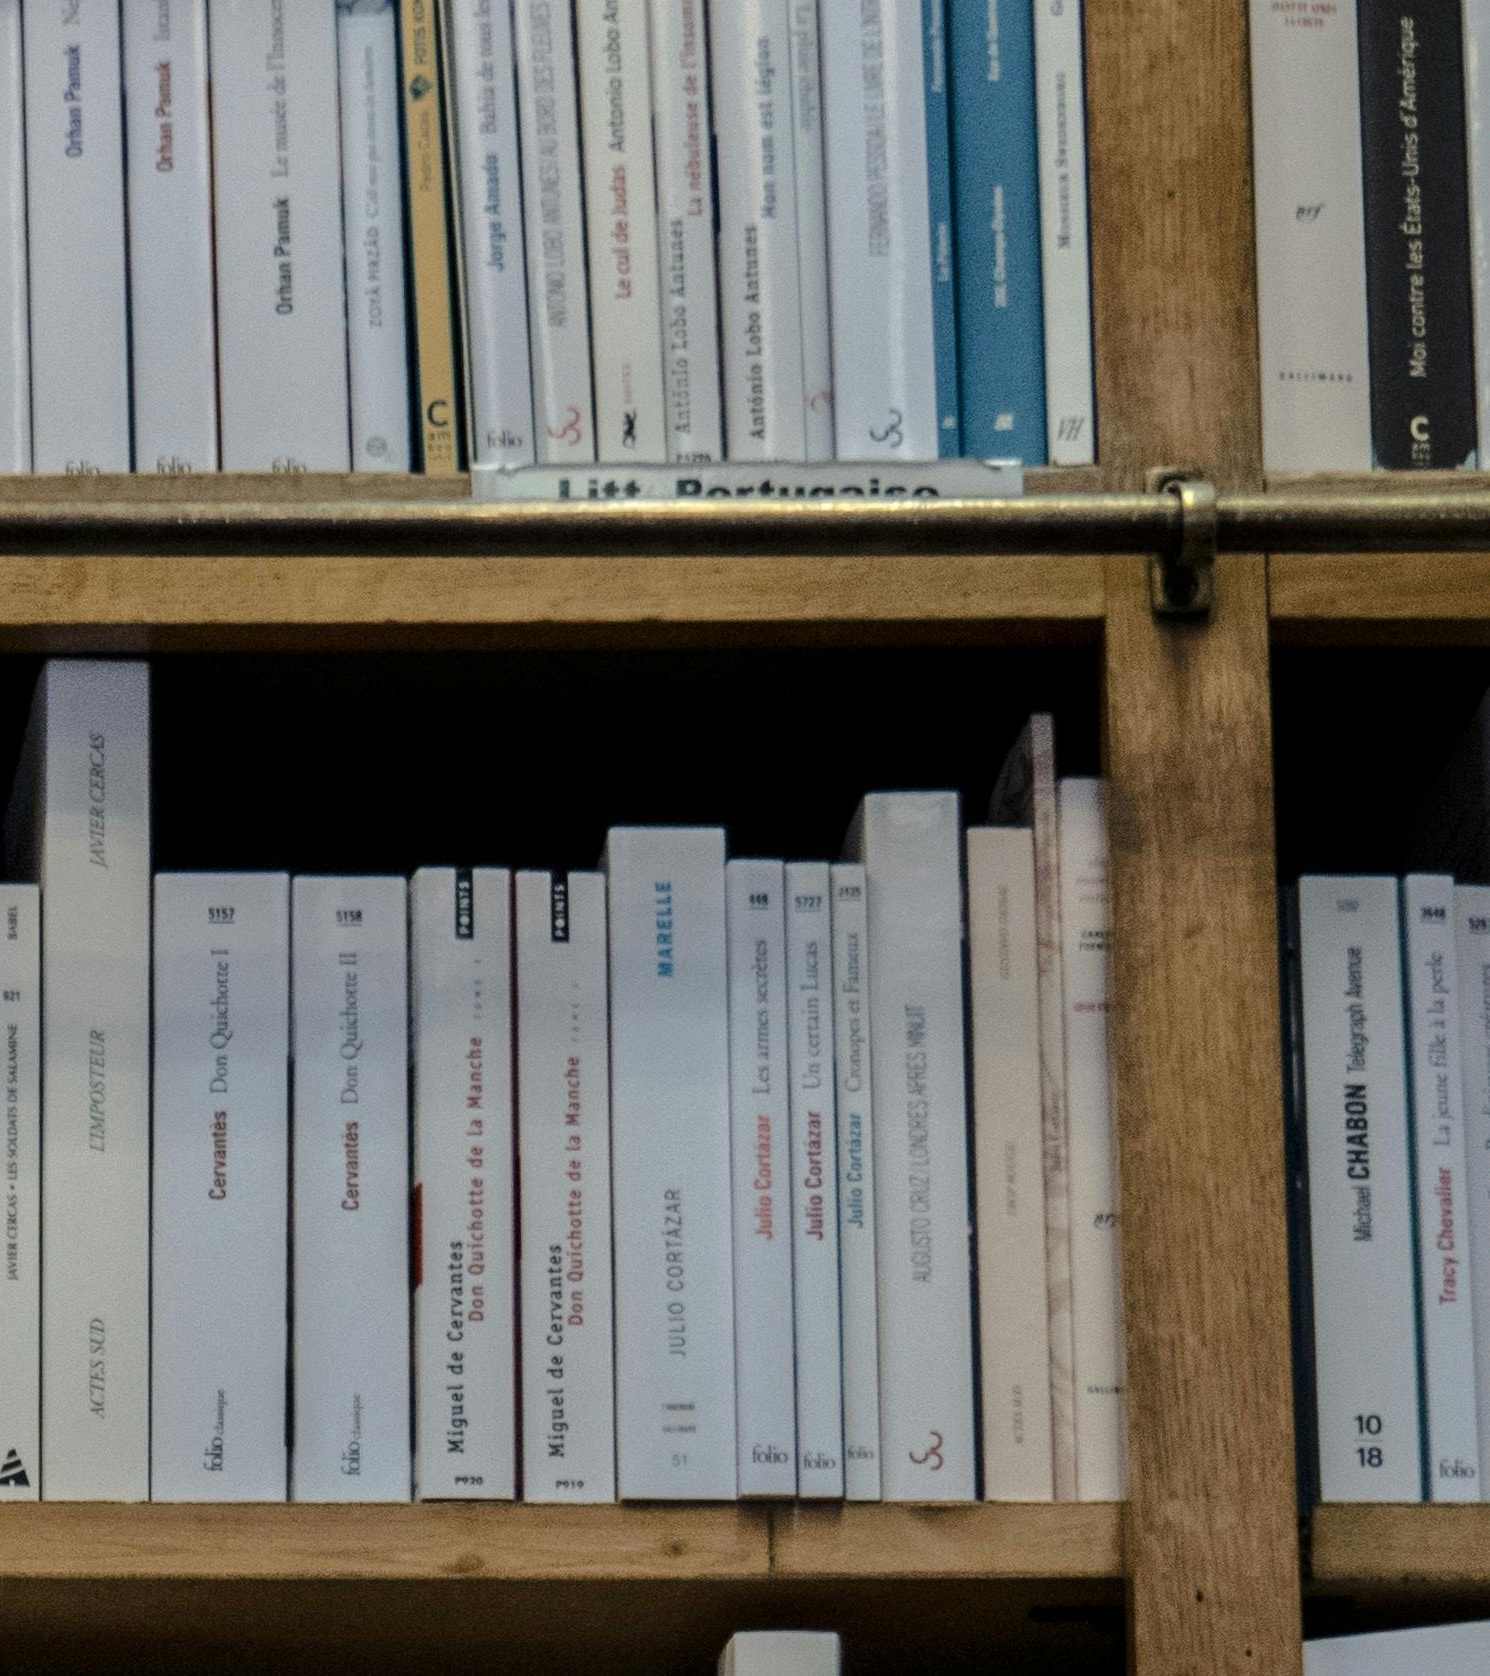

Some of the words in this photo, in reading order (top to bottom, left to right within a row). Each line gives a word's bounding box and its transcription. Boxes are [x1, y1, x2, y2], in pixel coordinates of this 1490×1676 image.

[1397, 15, 1420, 129] d'Amérique
[1398, 130, 1423, 236] États-Unis
[487, 218, 509, 273] Jorge
[1404, 238, 1425, 271] les
[1407, 272, 1427, 339] contre
[1407, 340, 1428, 379] Moi
[653, 880, 675, 979] MARELLE
[1343, 945, 1364, 1000] Avenue
[1342, 1082, 1372, 1181] CHABON
[661, 1187, 686, 1293] CORTÁZAR
[1352, 1184, 1373, 1242] Michael
[445, 1239, 465, 1343] Cervantes
[445, 1350, 465, 1376] de
[666, 1300, 687, 1359] JULIO
[445, 1383, 470, 1455] Miguel
